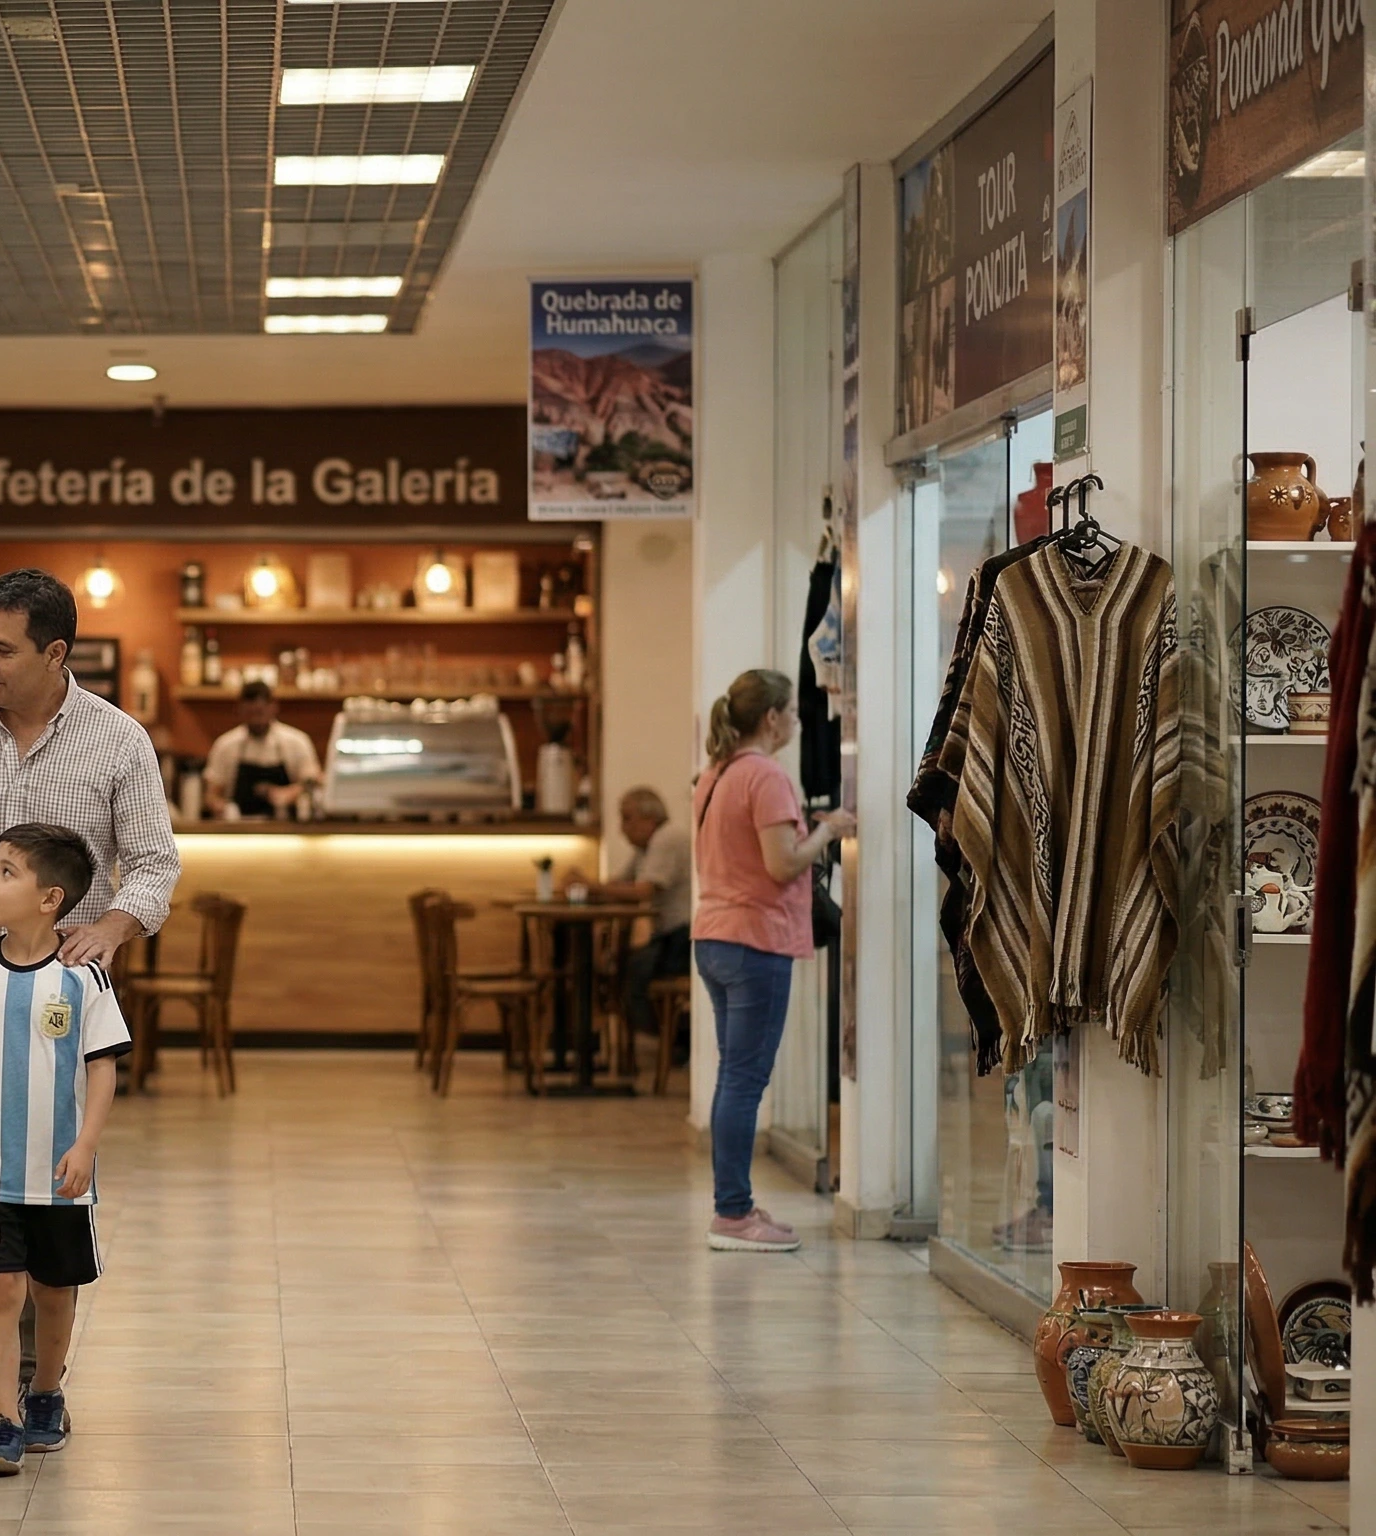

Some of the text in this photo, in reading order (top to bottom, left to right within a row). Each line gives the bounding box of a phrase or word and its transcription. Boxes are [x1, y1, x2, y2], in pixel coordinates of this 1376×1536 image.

[977, 152, 1017, 235] TOUR
[541, 288, 683, 312] Quebrada de
[170, 457, 236, 505] de
[251, 457, 297, 505] la
[312, 457, 500, 505] Galería
